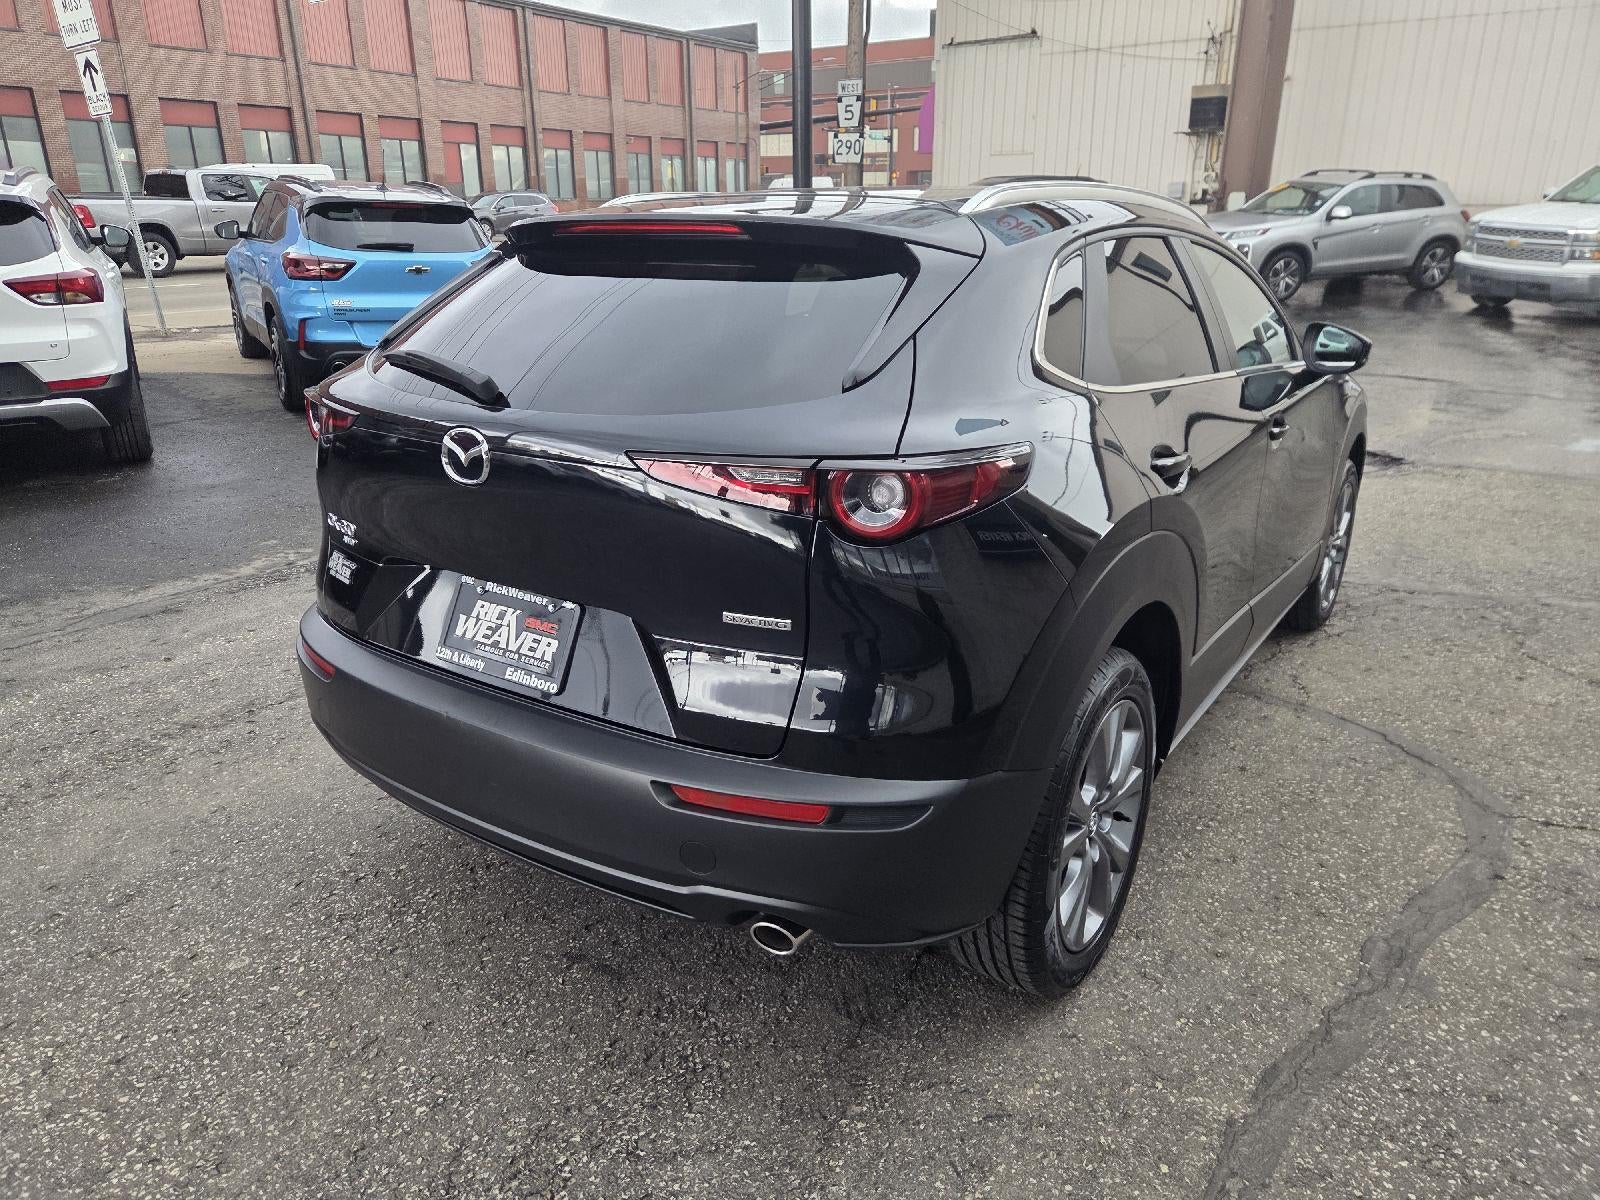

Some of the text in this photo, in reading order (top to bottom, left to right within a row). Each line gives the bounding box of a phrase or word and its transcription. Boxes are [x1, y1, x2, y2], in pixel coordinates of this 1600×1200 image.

[62, 17, 96, 37] TURN LEFT
[88, 92, 107, 105] BLACK
[841, 83, 859, 93] WEST
[844, 104, 854, 120] 5
[836, 139, 861, 155] 290
[486, 581, 549, 606] RickWeaver
[471, 599, 522, 628] RICK
[524, 616, 560, 635] GMC
[454, 613, 559, 662] WEAVER
[435, 646, 486, 672] 12th & Liberty
[476, 643, 550, 670] FAMOUS FOR SERVICE
[505, 667, 558, 694] Edinboro
